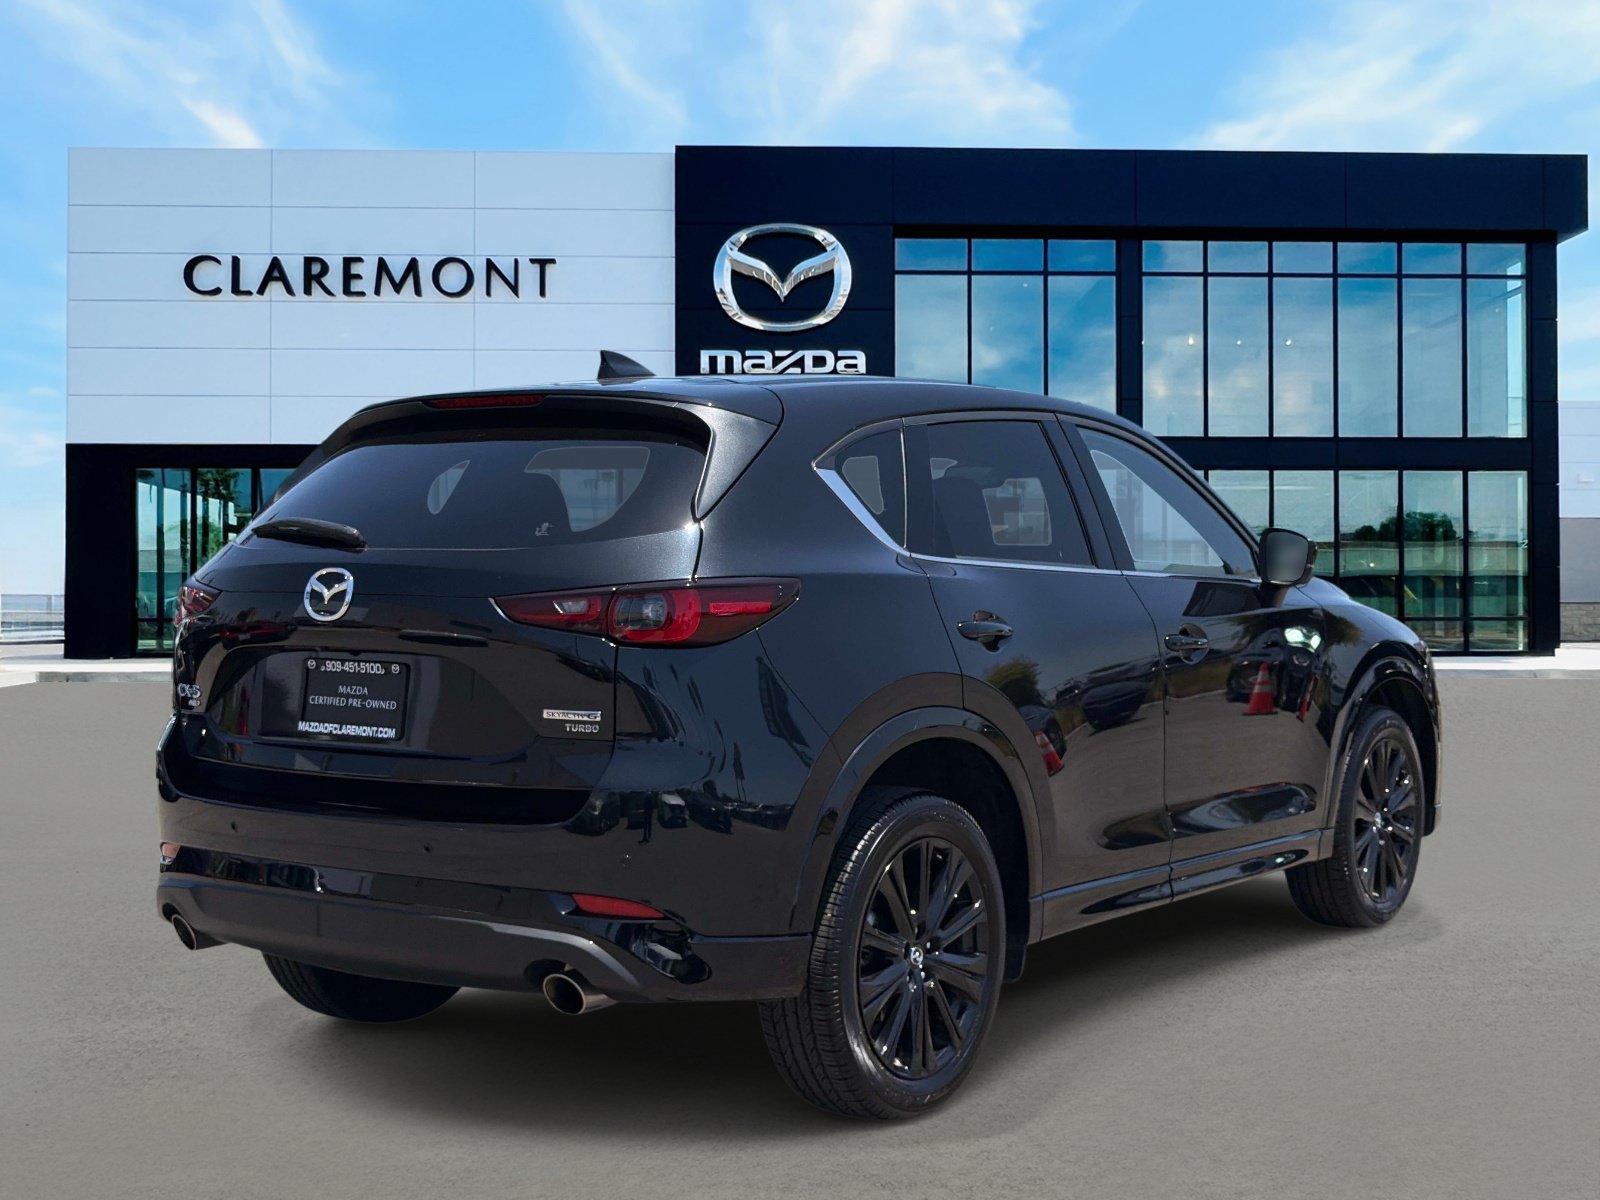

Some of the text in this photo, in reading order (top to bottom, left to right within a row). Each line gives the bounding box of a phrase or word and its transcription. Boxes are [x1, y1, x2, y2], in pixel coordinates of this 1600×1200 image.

[183, 254, 557, 299] CLAREMONT
[700, 350, 866, 374] mazda
[338, 685, 368, 695] MAZDA
[309, 695, 397, 710] CERTIFIED PRE-OWNED
[298, 721, 396, 738] MAZDAOFCLAREMONT.COM
[565, 723, 599, 732] TURBO
